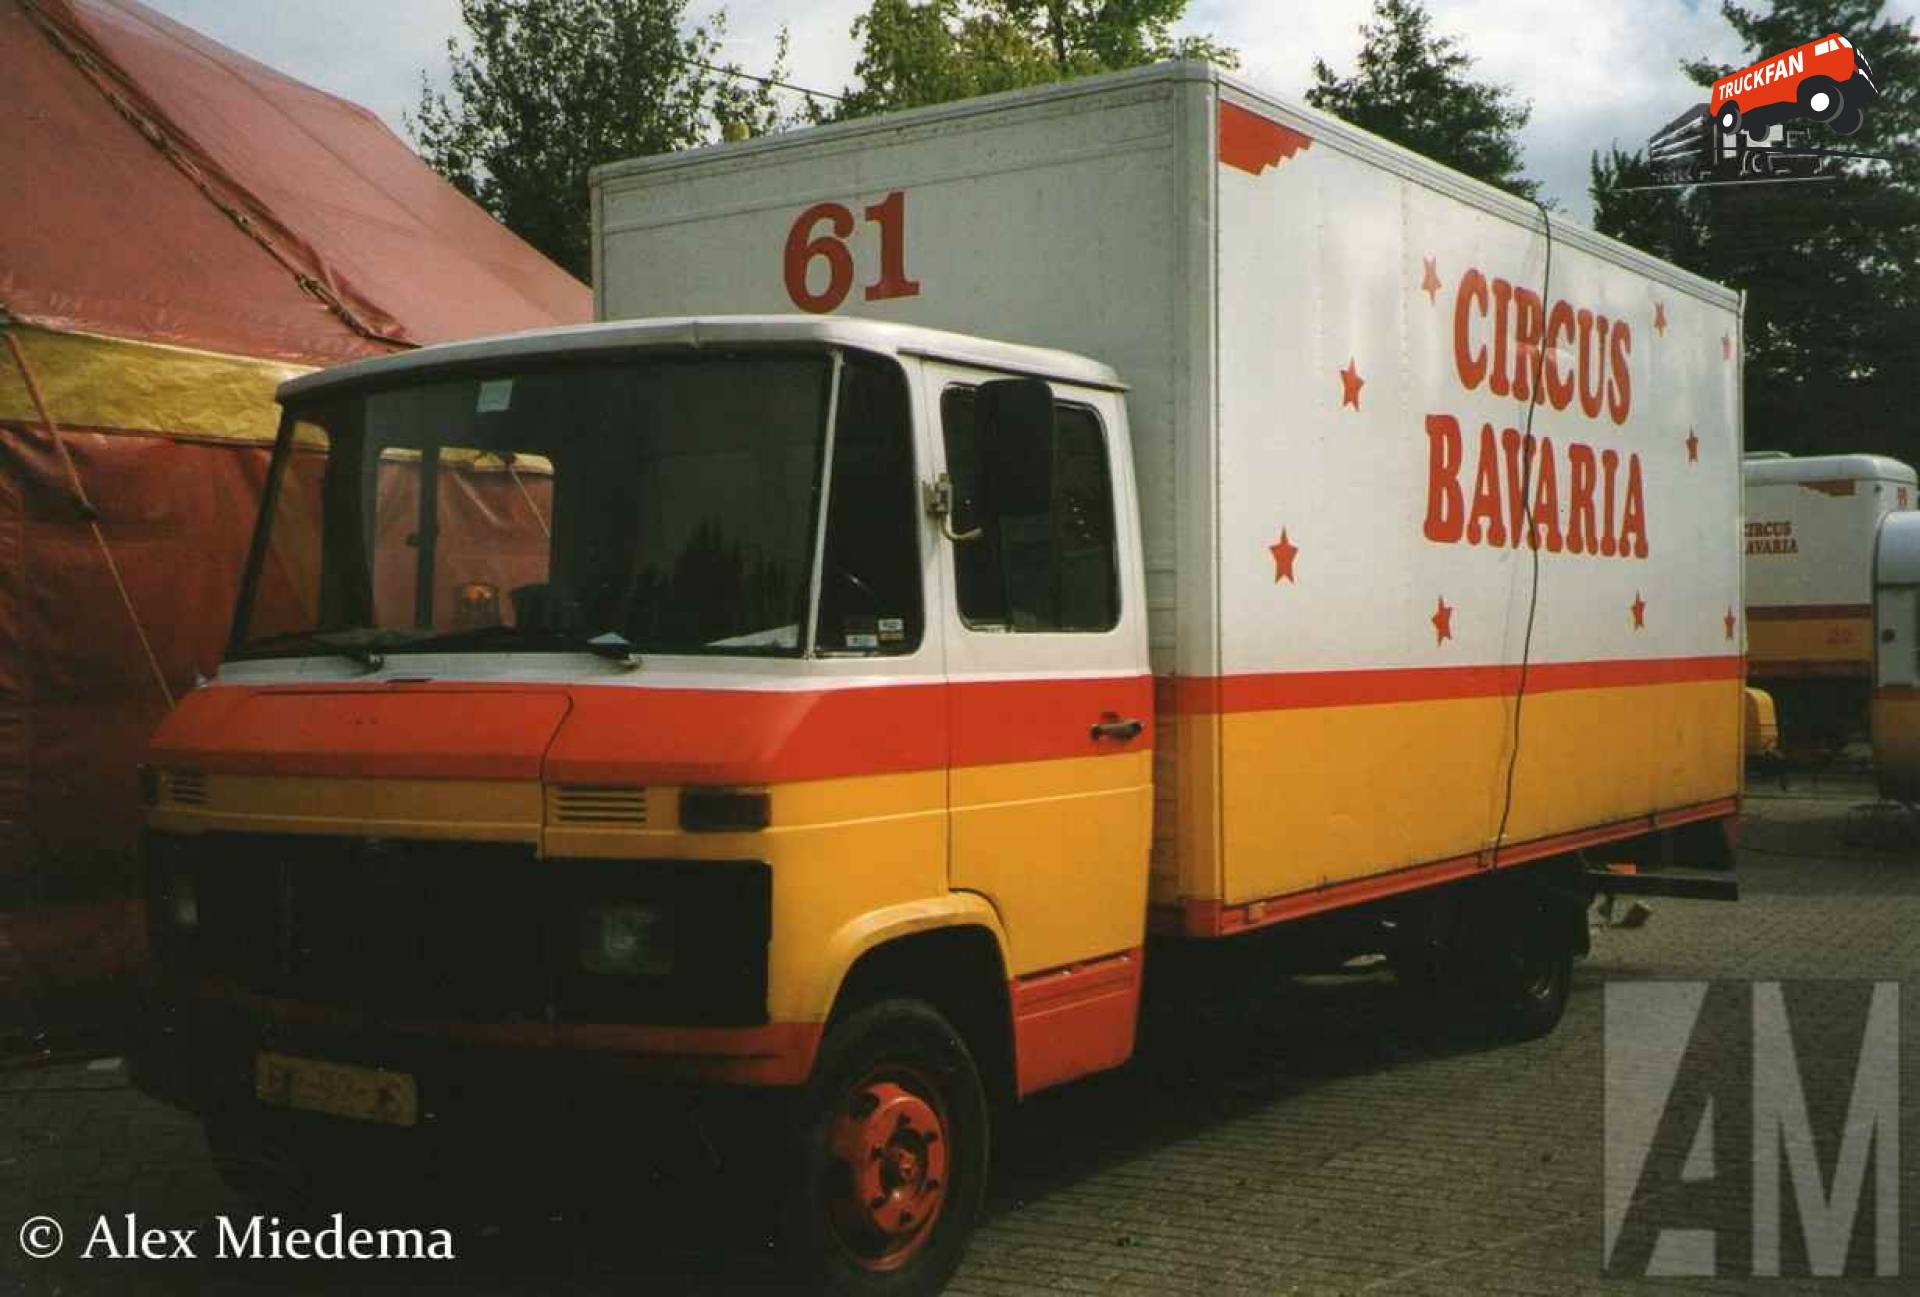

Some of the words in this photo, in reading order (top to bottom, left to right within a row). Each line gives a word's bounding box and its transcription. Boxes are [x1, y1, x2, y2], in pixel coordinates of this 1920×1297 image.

[784, 190, 920, 314] 61
[1454, 267, 1632, 425] CIRCUS
[1424, 413, 1650, 559] BAVARIA
